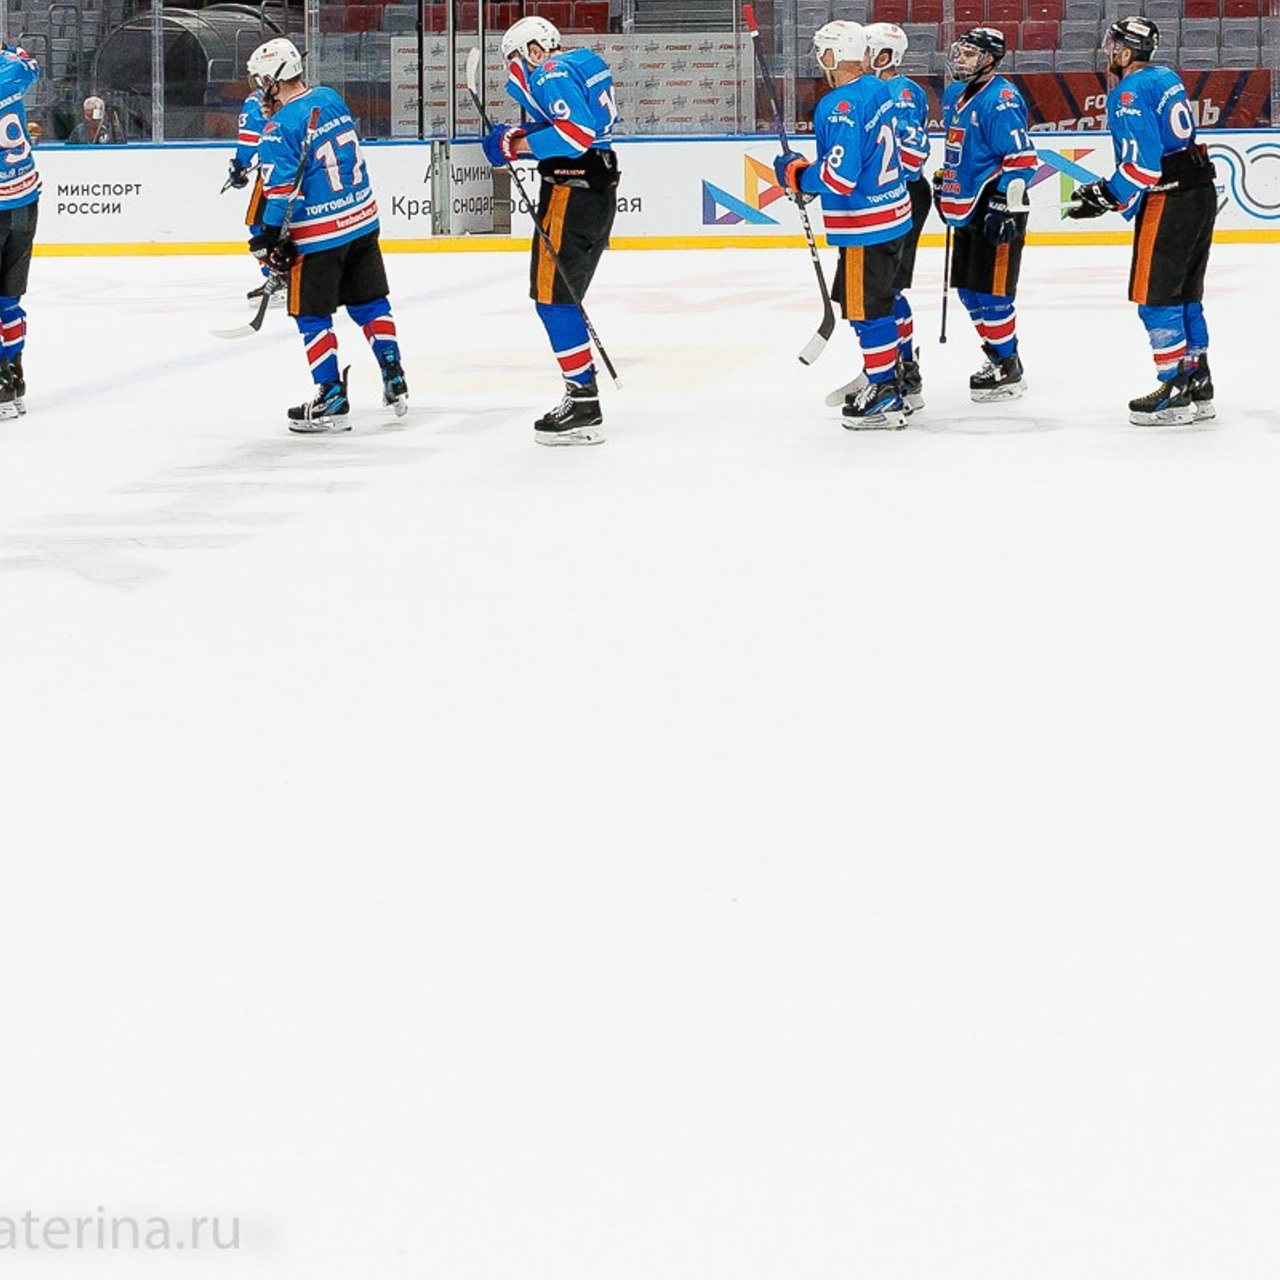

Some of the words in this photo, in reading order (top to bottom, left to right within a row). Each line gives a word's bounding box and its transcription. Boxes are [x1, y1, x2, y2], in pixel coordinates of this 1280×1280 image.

[315, 130, 363, 192] 17
[57, 183, 142, 197] МИНСПОРТ
[57, 202, 122, 215] РОССИИ
